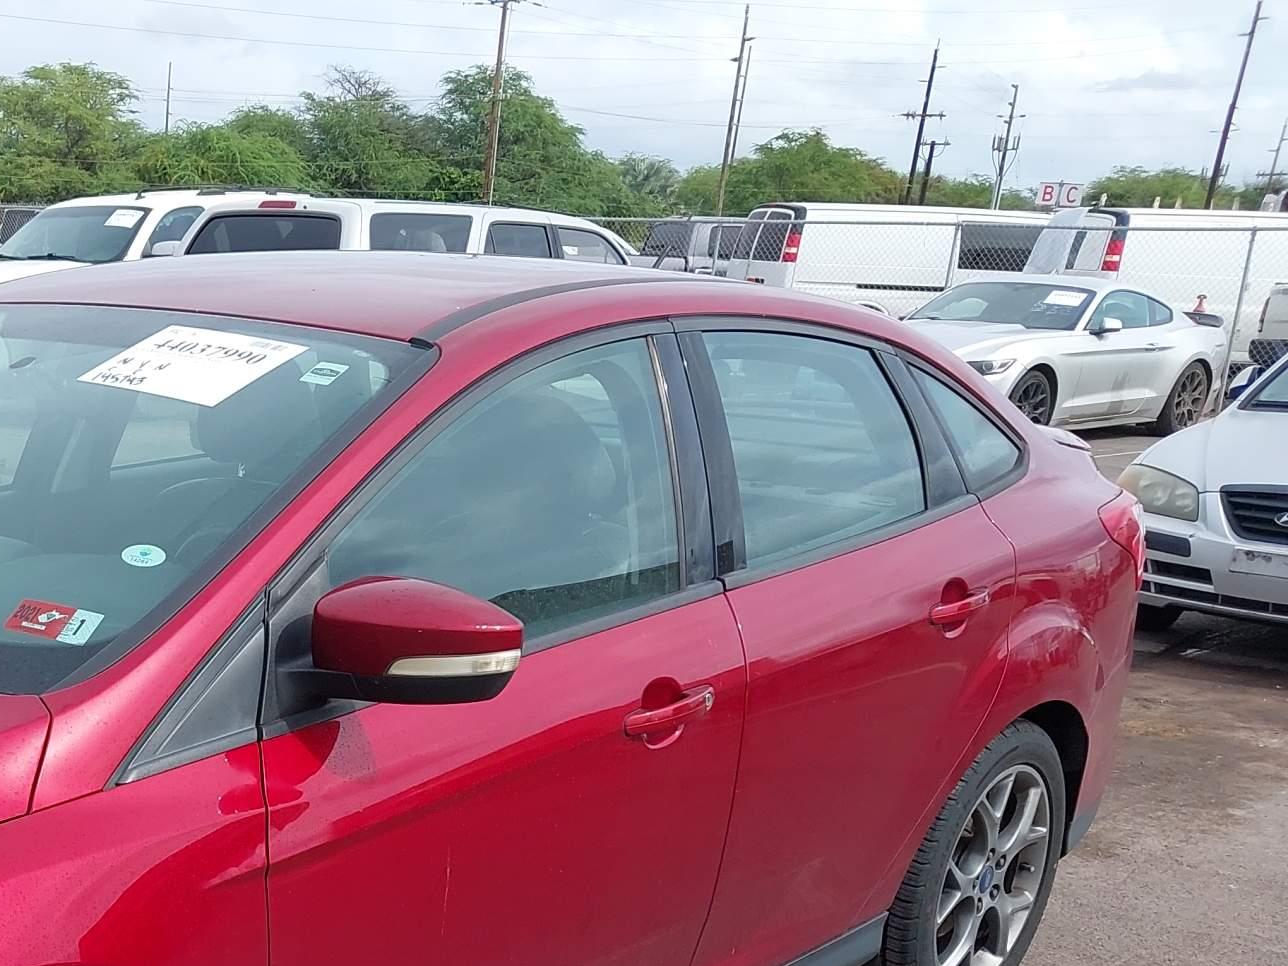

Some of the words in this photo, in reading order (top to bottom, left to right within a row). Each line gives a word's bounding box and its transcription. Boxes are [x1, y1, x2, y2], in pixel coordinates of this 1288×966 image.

[1041, 185, 1055, 202] B
[1066, 186, 1079, 203] C
[154, 339, 268, 365] 44037990
[72, 618, 87, 636] 1
